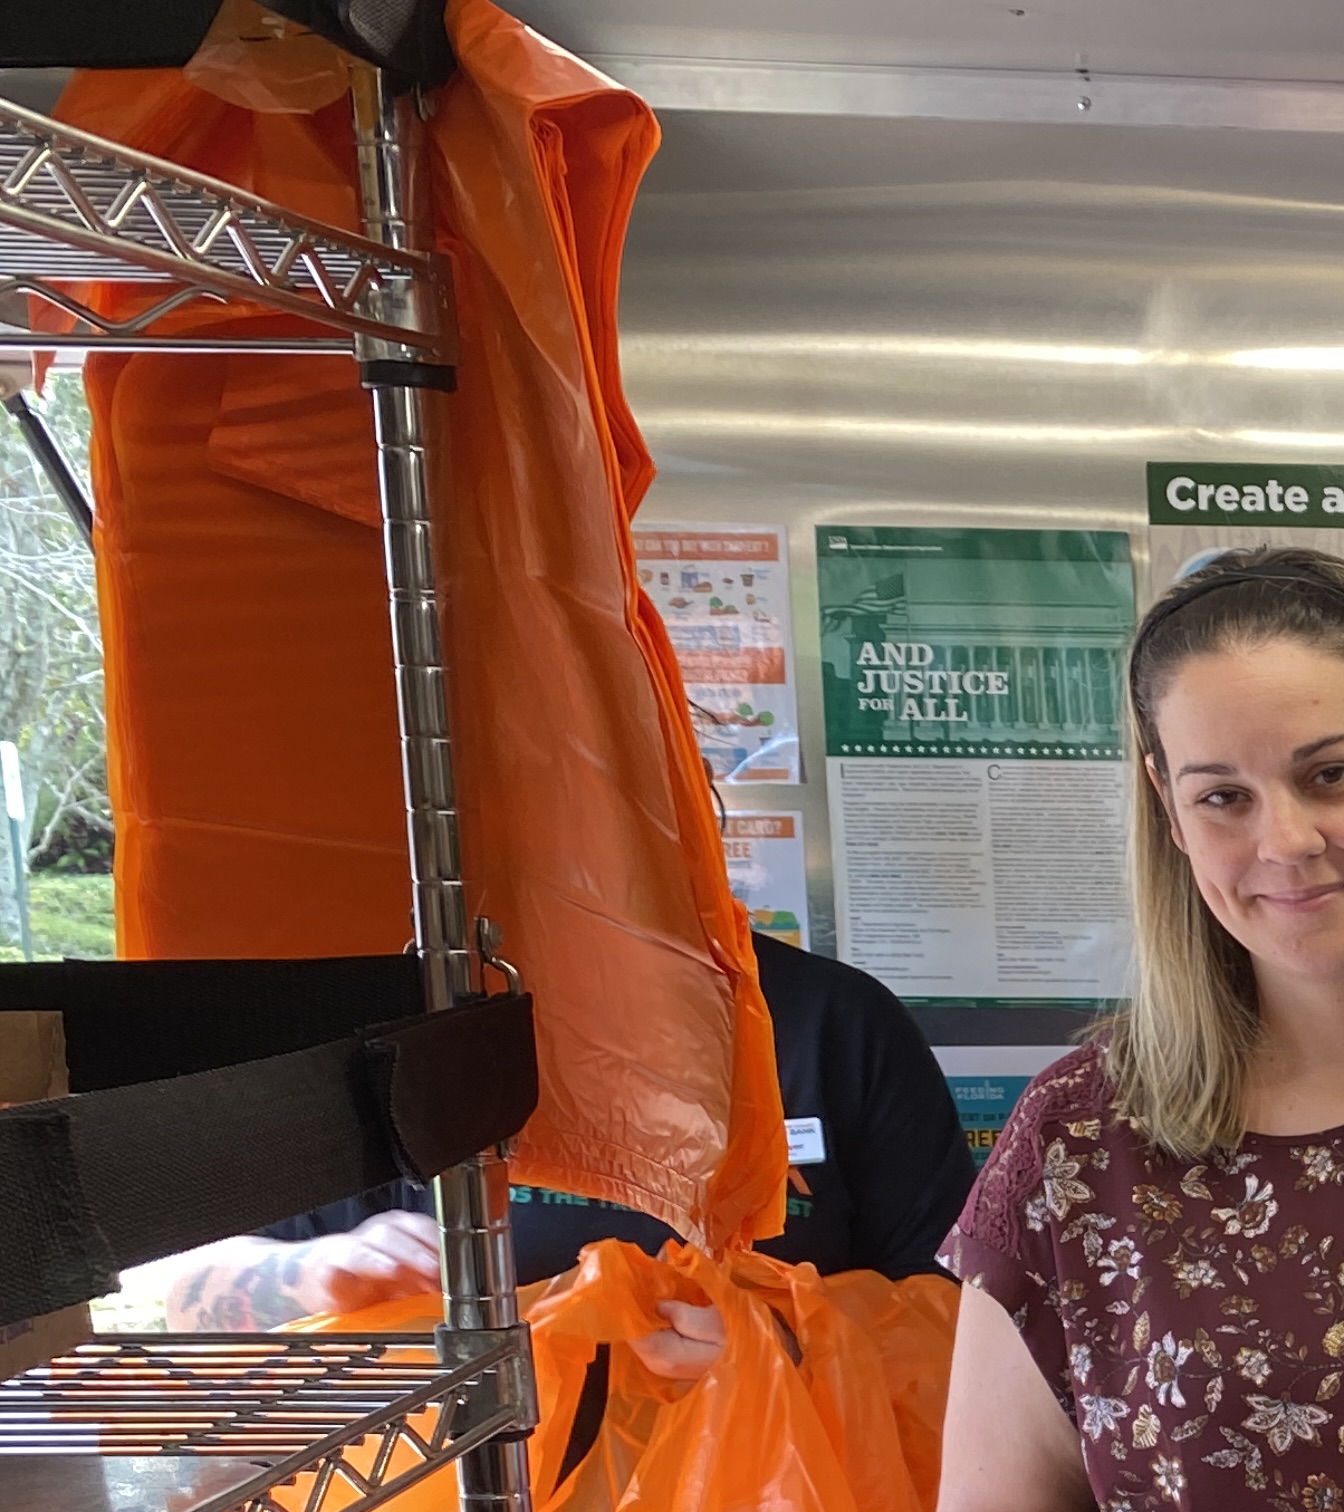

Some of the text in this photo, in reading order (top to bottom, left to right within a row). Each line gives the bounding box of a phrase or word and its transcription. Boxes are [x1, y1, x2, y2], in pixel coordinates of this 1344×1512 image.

[1166, 476, 1308, 513] Create
[857, 641, 935, 666] AND
[857, 669, 1010, 695] JUSTICE
[858, 697, 968, 721] FOR ALL
